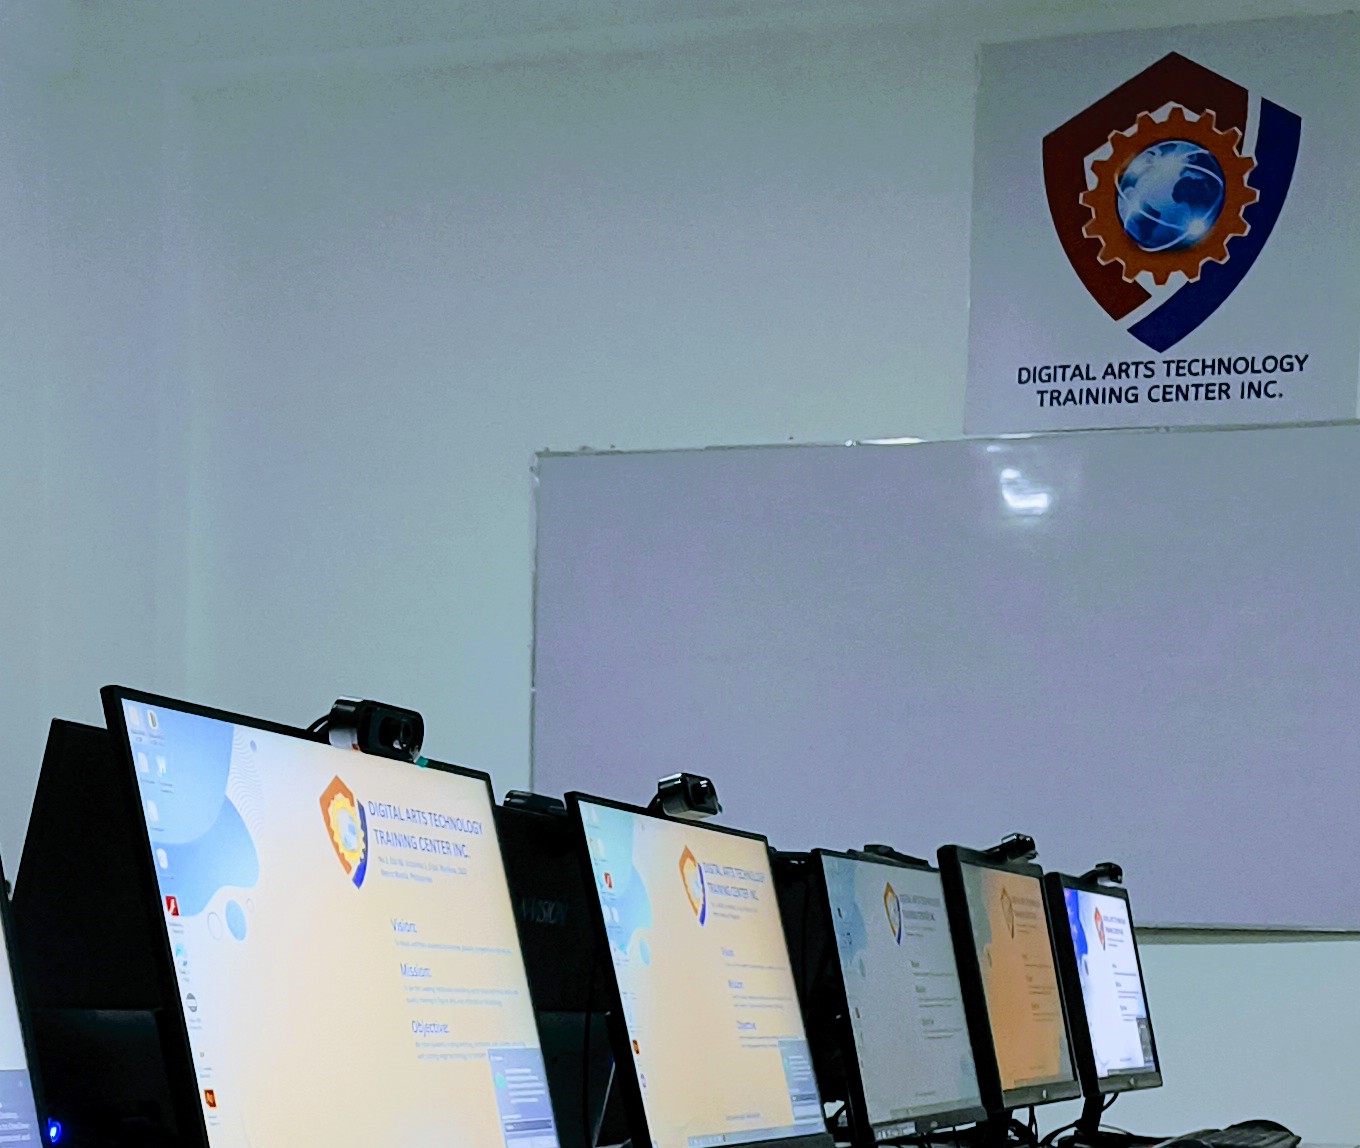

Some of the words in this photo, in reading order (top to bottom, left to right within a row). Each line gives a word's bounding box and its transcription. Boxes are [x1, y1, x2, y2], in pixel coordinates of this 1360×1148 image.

[1017, 363, 1097, 385] DIGITAL
[1102, 360, 1156, 380] ARTS
[1162, 354, 1309, 378] TECHNOLOGY
[1036, 385, 1140, 408] TRAINING
[1147, 382, 1231, 403] CENTER
[1240, 380, 1284, 400] INC.
[368, 801, 405, 820] DIGITAL
[405, 809, 428, 825] ARTS
[428, 812, 483, 834] TECHNOLOGY
[373, 829, 417, 849] TRAINING
[419, 837, 452, 855] CENTER
